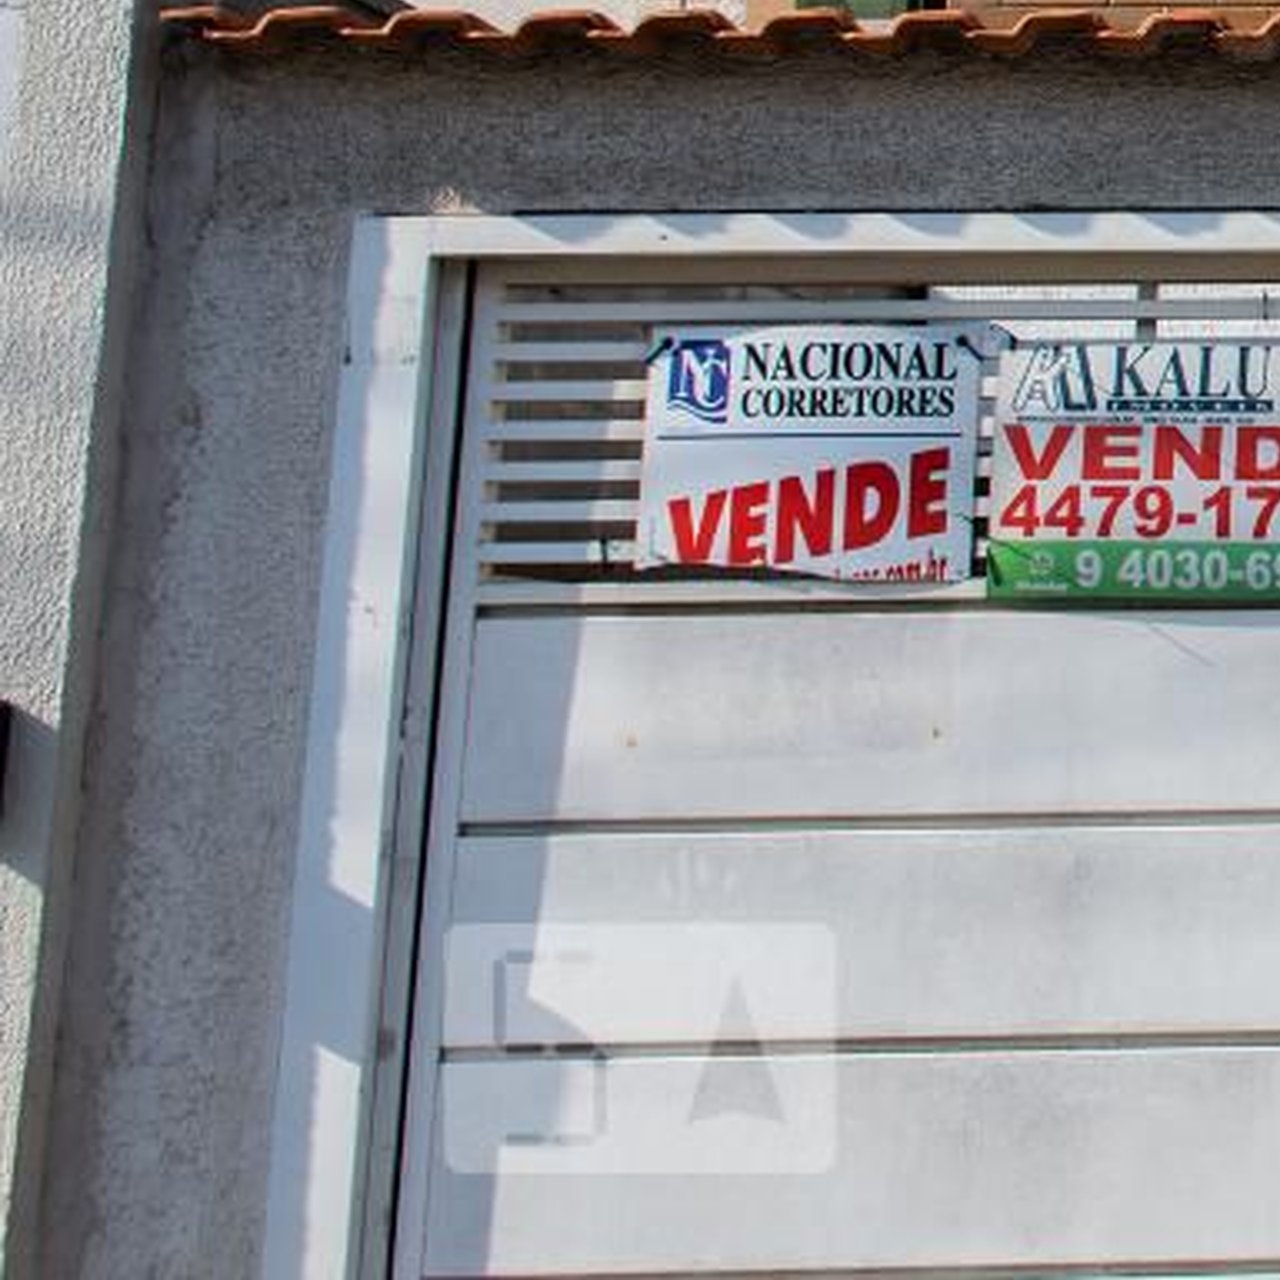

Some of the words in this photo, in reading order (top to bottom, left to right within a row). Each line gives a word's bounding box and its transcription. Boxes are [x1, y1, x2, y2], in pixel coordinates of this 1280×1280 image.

[741, 342, 957, 381] NACIONAL
[1108, 347, 1271, 397] KALU
[741, 385, 955, 419] CORRETORES
[668, 447, 949, 566] VENDE
[1076, 551, 1101, 587] 9
